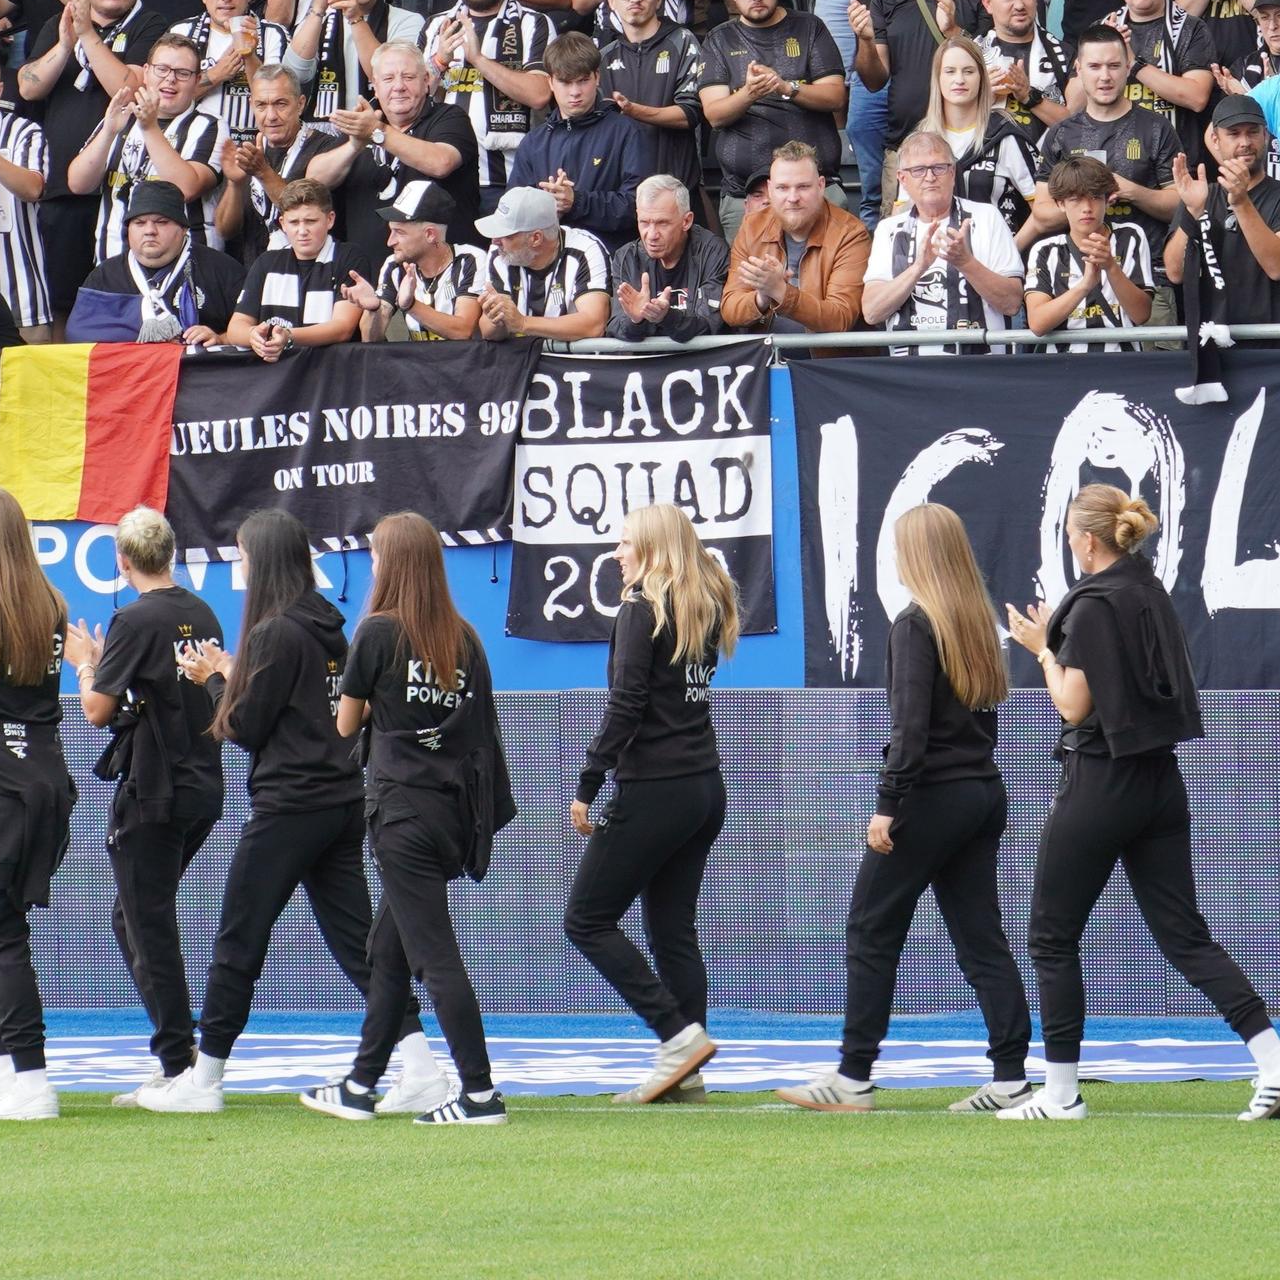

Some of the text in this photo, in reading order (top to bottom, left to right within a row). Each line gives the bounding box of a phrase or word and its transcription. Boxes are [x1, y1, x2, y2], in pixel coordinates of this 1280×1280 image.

[488, 113, 527, 124] CHARLERO
[522, 365, 755, 440] BLACK
[169, 400, 519, 457] UEULES NOIRES 98
[273, 461, 375, 492] ON TOUR
[522, 456, 753, 535] SQUAD
[406, 659, 466, 691] KIG
